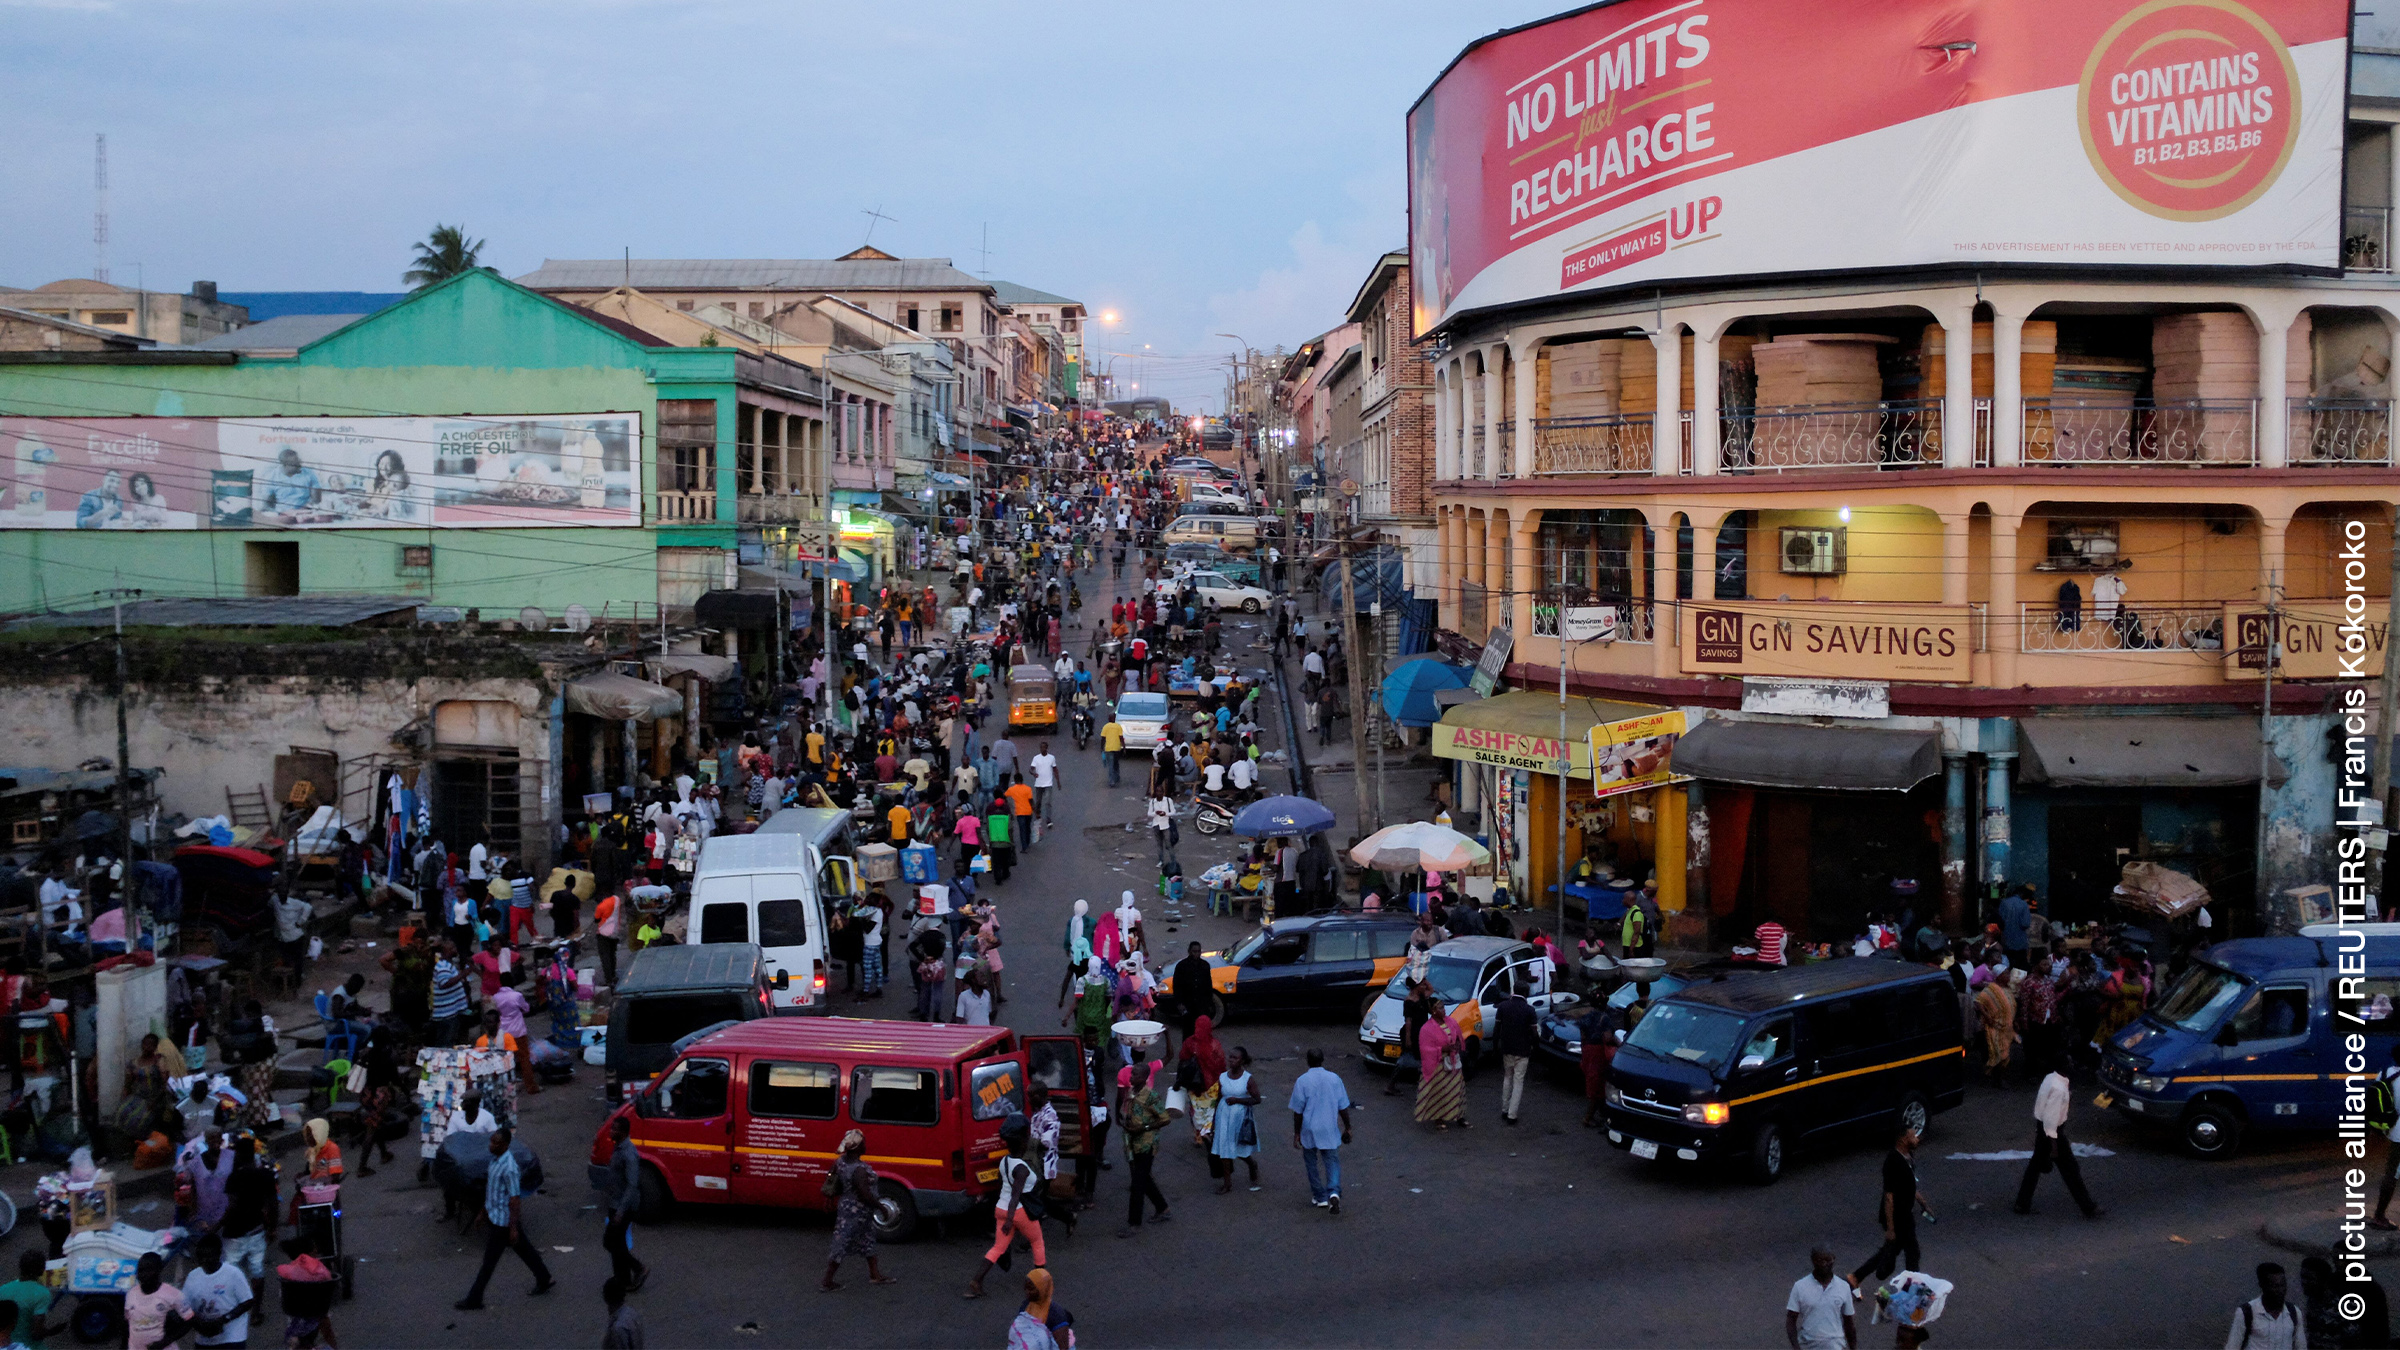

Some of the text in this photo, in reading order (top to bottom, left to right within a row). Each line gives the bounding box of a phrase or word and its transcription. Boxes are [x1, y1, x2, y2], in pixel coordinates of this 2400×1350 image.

[1507, 14, 1710, 149] NO LIMITS
[2111, 52, 2259, 105] CONTAINS
[1575, 91, 1617, 152] just
[2107, 86, 2273, 147] VITAMINS
[2133, 130, 2262, 166] B1, B2, B3, B5, B6
[1510, 101, 1716, 226] RECHARGE
[1565, 195, 1723, 277] THE ONLY WAY IS UP
[1980, 243, 2070, 251] ADVERTISEMENT
[2073, 243, 2095, 251] HAS
[2098, 243, 2126, 251] BEEN
[2130, 243, 2170, 251] VETTED
[2174, 243, 2196, 251] AND
[2199, 243, 2256, 252] APPROVED
[2259, 243, 2272, 251] BY
[2275, 242, 2294, 250] THE
[2297, 241, 2316, 250] FDA
[88, 432, 160, 454] Excella
[259, 434, 307, 445] Fortune
[319, 436, 343, 444] there
[344, 436, 357, 444] for
[358, 437, 374, 446] you
[271, 425, 314, 433] Whatever
[315, 426, 336, 434] your
[440, 430, 536, 441] A CHOLESTEROL
[440, 440, 517, 455] FREE OIL
[1701, 615, 1737, 643] GN
[1750, 623, 1956, 657] GN SAVINGS
[2286, 624, 2322, 653] GN
[1701, 648, 1738, 658] SAVINGS
[1476, 752, 1543, 769] SALES AGENT
[1272, 815, 1291, 825] tigo
